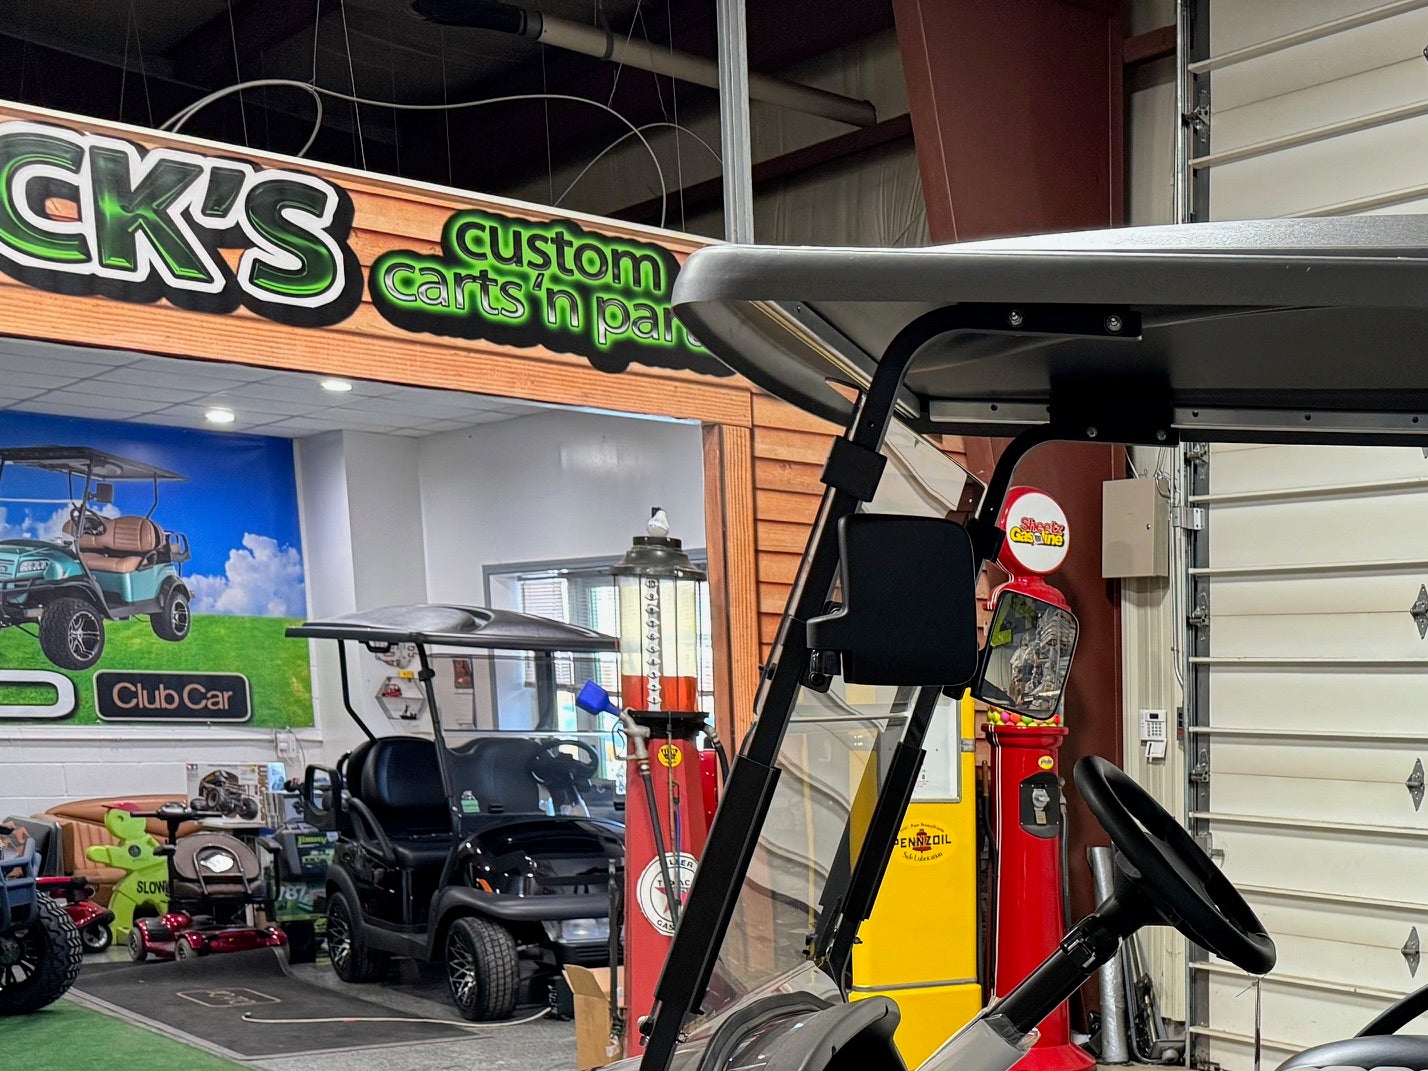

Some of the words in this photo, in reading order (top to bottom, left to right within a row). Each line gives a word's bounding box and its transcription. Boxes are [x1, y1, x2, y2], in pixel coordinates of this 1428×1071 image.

[456, 221, 662, 291] custom
[384, 262, 525, 318] carts
[598, 296, 702, 347] par
[112, 681, 180, 709] Club
[182, 683, 233, 710] Car
